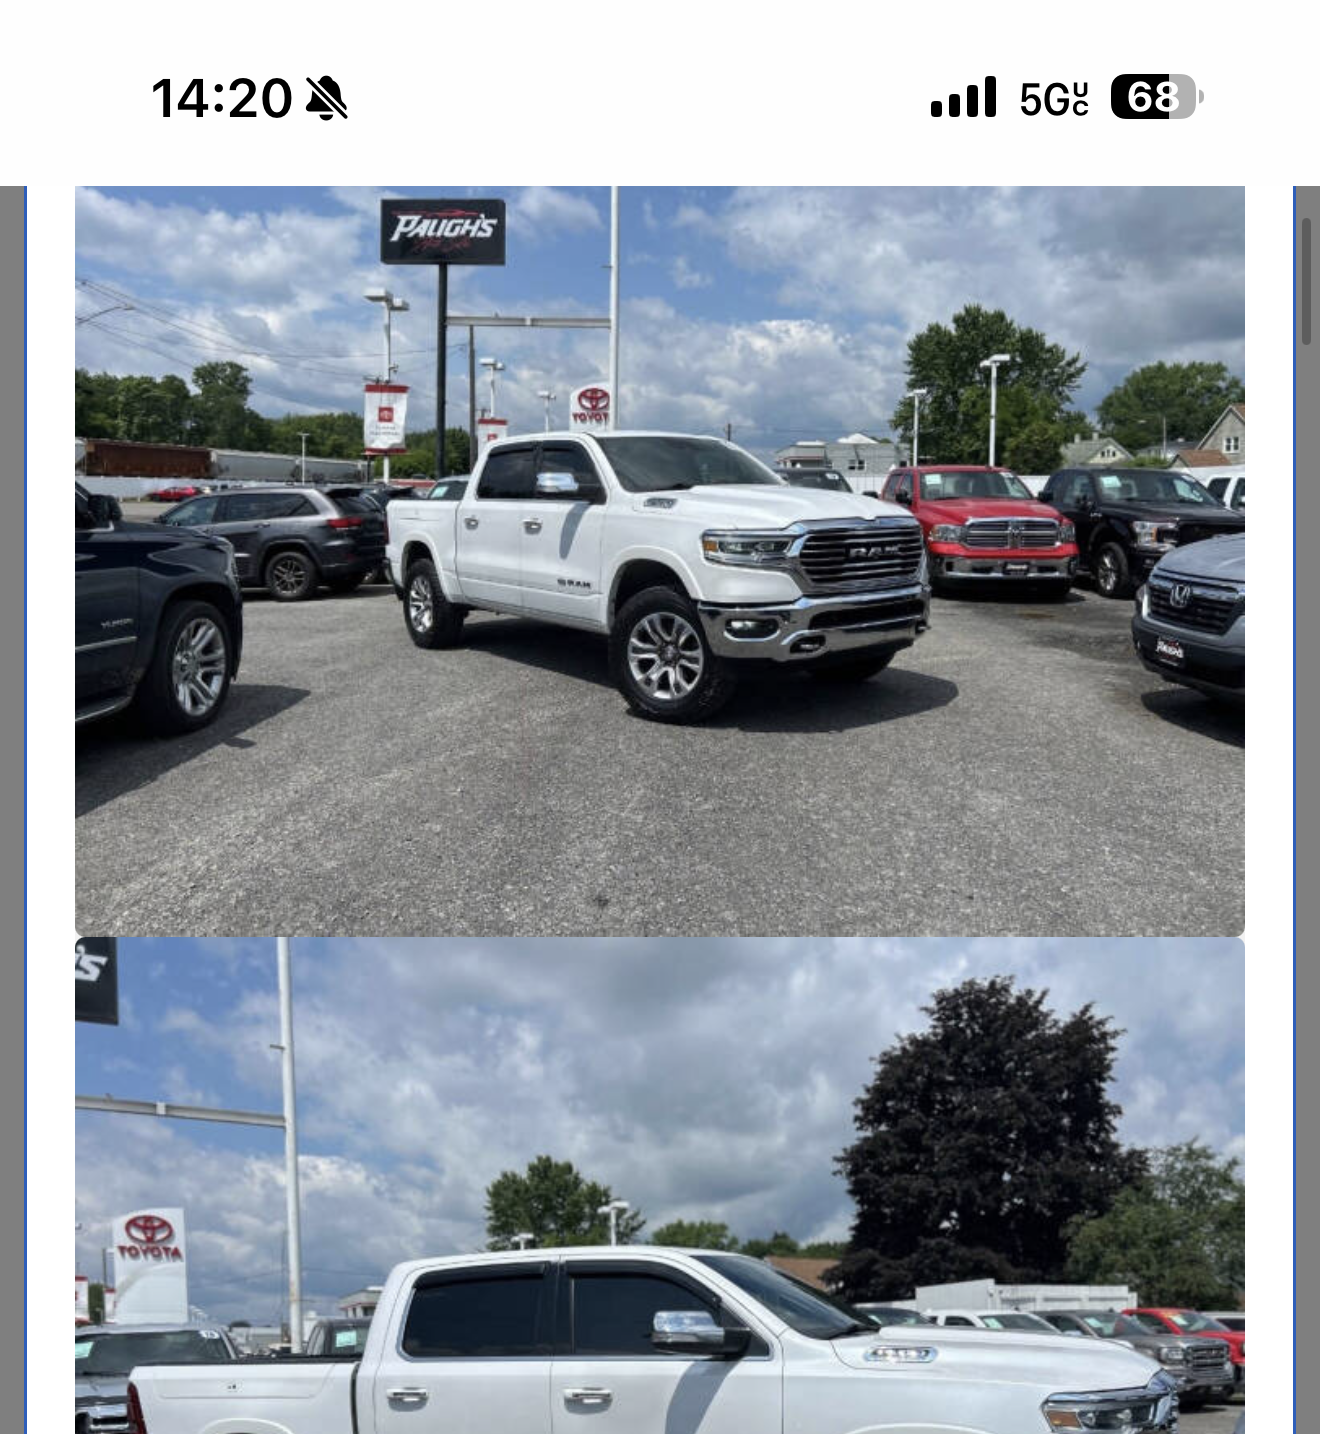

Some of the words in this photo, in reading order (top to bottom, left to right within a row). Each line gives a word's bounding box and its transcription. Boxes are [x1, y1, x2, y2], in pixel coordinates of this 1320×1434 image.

[152, 77, 292, 119] 14:20
[1127, 80, 1180, 113] 68
[390, 213, 498, 242] PAUGH'S
[571, 411, 610, 425] TOYOT
[850, 544, 899, 560] RAM
[566, 579, 592, 590] RAM
[117, 1245, 184, 1262] TOYOTA
